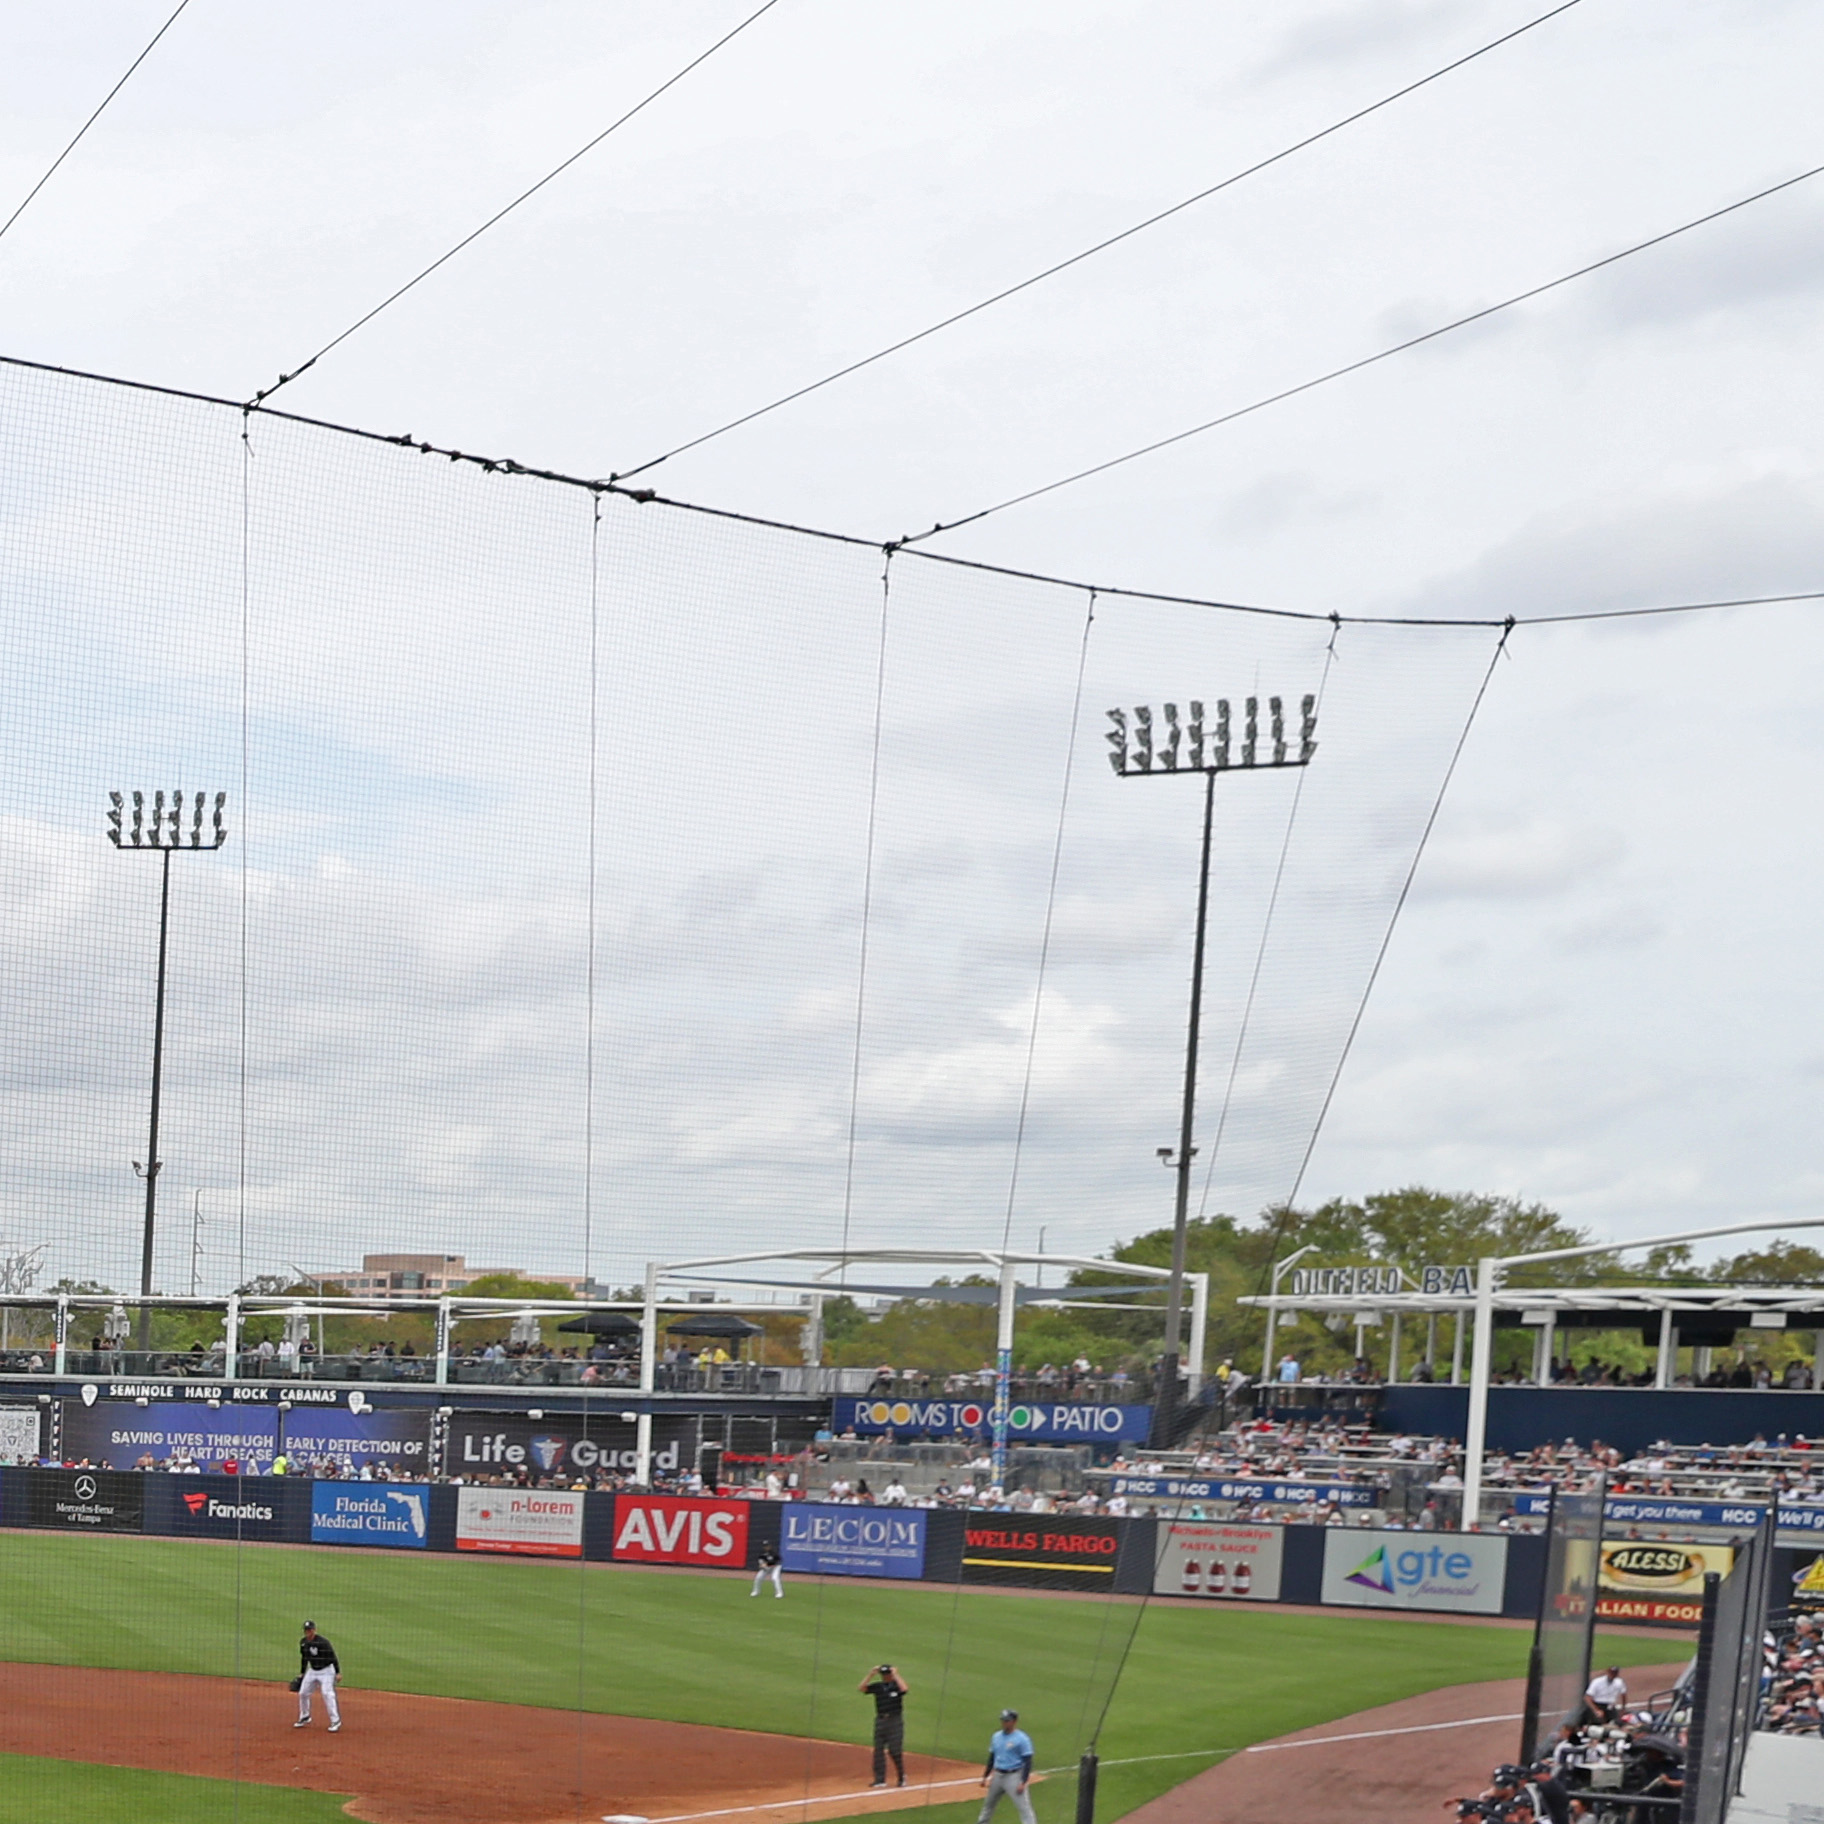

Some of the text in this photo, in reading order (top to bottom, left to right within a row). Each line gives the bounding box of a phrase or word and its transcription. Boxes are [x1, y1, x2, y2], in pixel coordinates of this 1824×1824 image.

[1292, 1266, 1402, 1295] OUTFIELD
[109, 1384, 337, 1401] SEMINOLE HARD ROCK CABANAS
[855, 1401, 947, 1428] ROOMS
[950, 1404, 983, 1428] TO
[1053, 1406, 1125, 1433] PATIO
[111, 1431, 274, 1448] SAVING LIVES THROUGH
[285, 1437, 424, 1455] EARLY DETECTION OF
[463, 1433, 526, 1464] Life
[215, 1447, 273, 1461] DISEASE
[1127, 1477, 1317, 1501] HCC HCC
[56, 1502, 115, 1516] Mercedes-Benz
[208, 1499, 273, 1521] Fanatics
[335, 1496, 387, 1514] Florida
[510, 1497, 574, 1515] n-lorem
[1613, 1502, 1636, 1520] get
[1635, 1504, 1663, 1521] you
[1666, 1505, 1702, 1521] there
[1722, 1509, 1757, 1524] HCC
[76, 1513, 102, 1524] Tampa
[312, 1513, 409, 1532] Medical Clinic
[509, 1514, 574, 1526] FOUNDATION
[614, 1507, 736, 1557] AVIS
[964, 1528, 1117, 1555] WELLS FARGO
[1180, 1540, 1258, 1554] PASTA SAUCE
[1397, 1544, 1472, 1586] gte
[1612, 1551, 1686, 1572] ALESSI
[1408, 1580, 1480, 1598] financial
